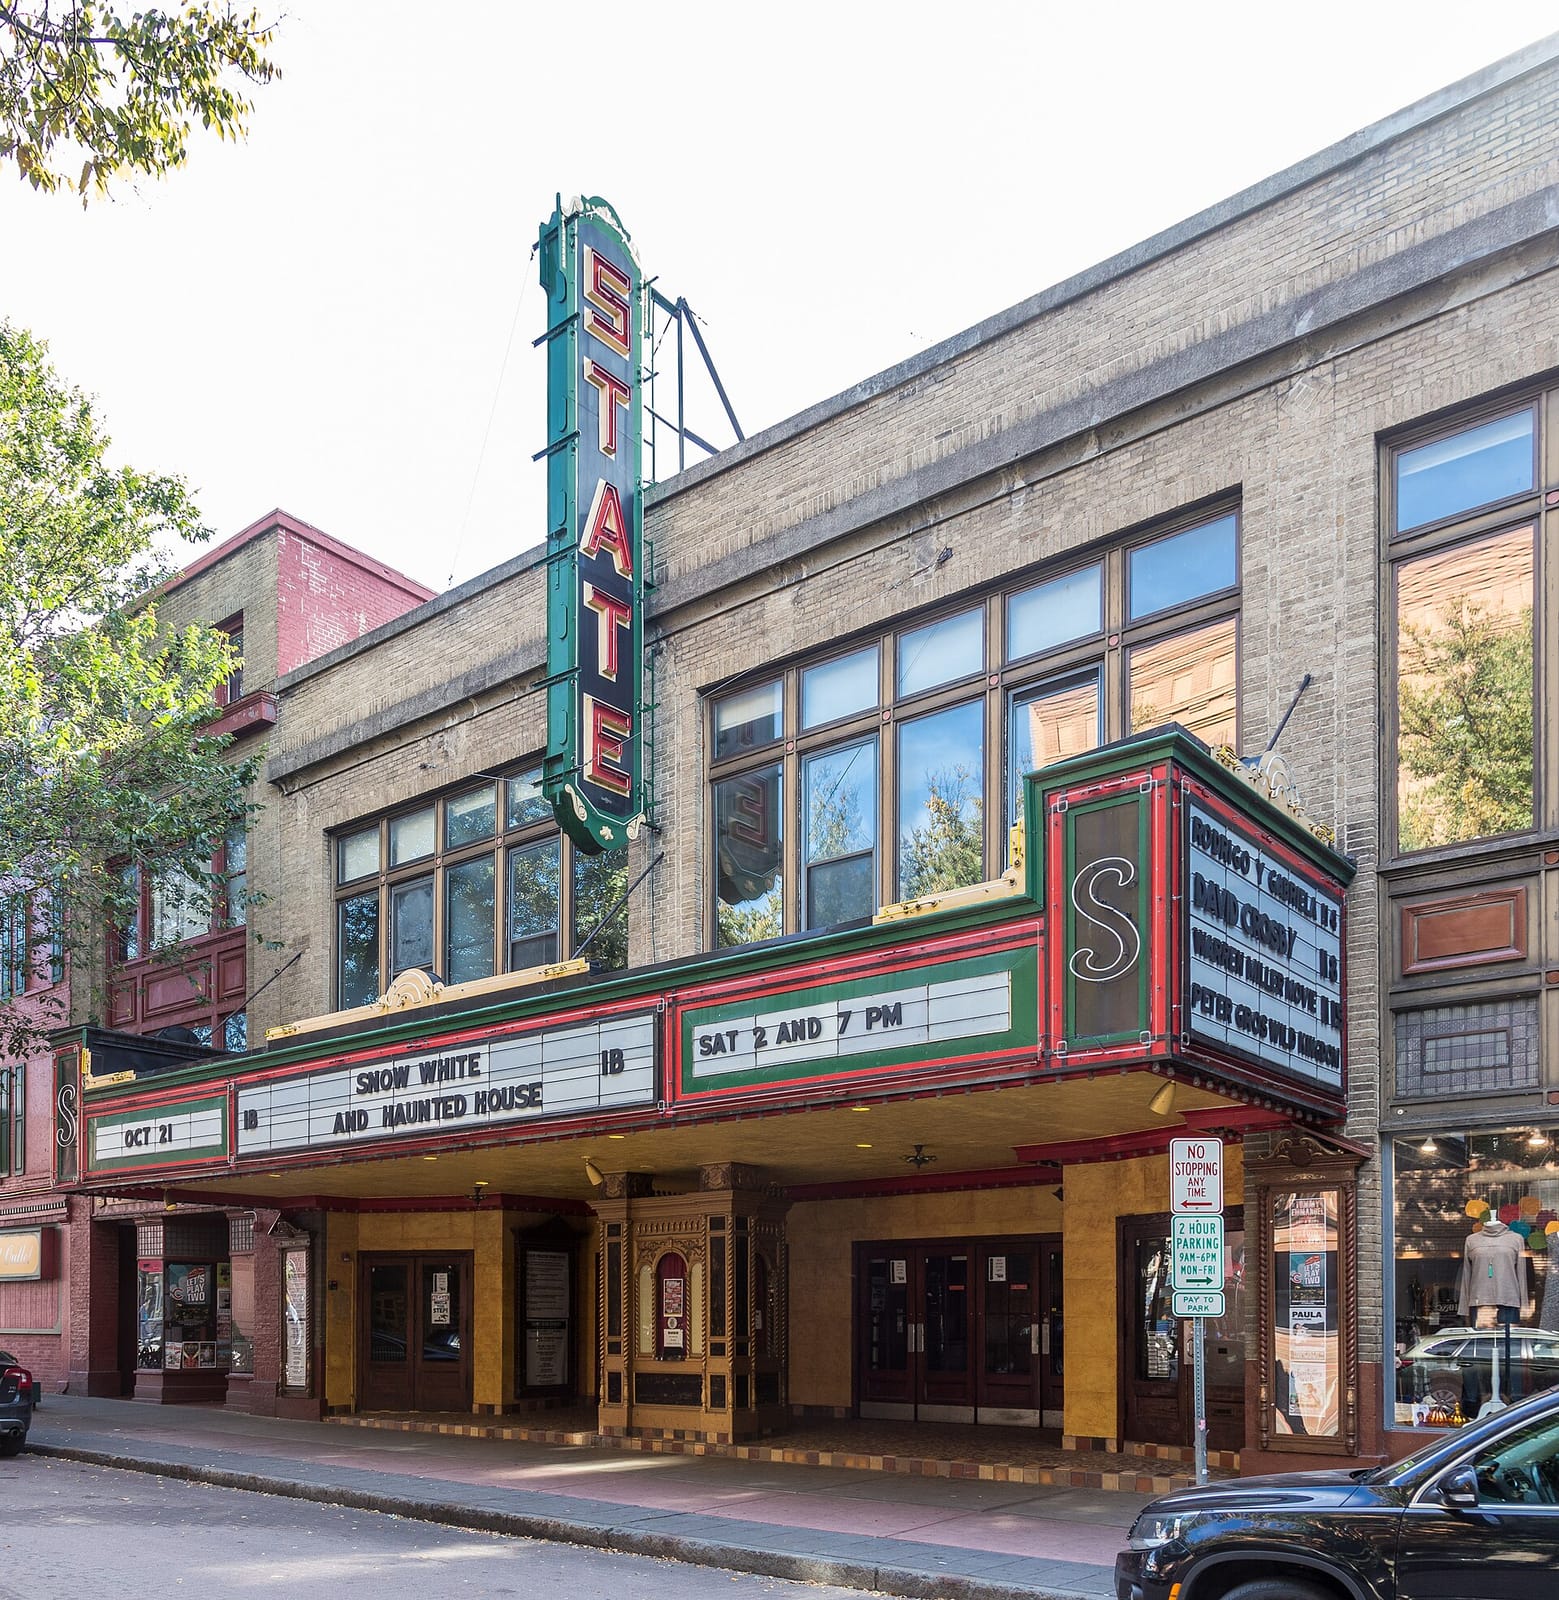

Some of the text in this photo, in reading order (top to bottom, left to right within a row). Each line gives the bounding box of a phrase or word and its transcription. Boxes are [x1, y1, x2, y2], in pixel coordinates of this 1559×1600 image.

[579, 243, 633, 798] STATE
[1192, 815, 1250, 875] RODRIGO
[1255, 858, 1265, 885] Y
[1267, 868, 1317, 921] GABRIELA
[1069, 856, 1141, 982] S
[1193, 871, 1239, 926] DAVID
[1240, 903, 1297, 959] CROSBY
[1191, 927, 1244, 977] WARREN
[1245, 955, 1284, 997] MILLER
[1284, 977, 1317, 1014] MOVIE
[698, 1001, 903, 1056] SAT 2 AND 7 PM
[1191, 982, 1340, 1069] PETER GROS WILD KINGDOM
[355, 1051, 481, 1095] SNOW WHITE
[332, 1081, 543, 1134] AND HAUNTED HOUSE
[124, 1123, 173, 1148] OCT 21
[1187, 1145, 1206, 1159] NO
[1175, 1162, 1218, 1176] STOPPING
[1187, 1177, 1206, 1187] ANY
[1187, 1188, 1207, 1197] TIME
[1179, 1223, 1216, 1235] 2 HOUR
[1176, 1238, 1219, 1250] PARKING
[1179, 1252, 1217, 1262] 9AM-6PM
[1180, 1265, 1216, 1275] MON-FRI
[186, 1274, 205, 1287] LET'S
[186, 1283, 204, 1294] PLAY
[187, 1292, 206, 1302] TWO
[1291, 1311, 1323, 1319] PAULA
